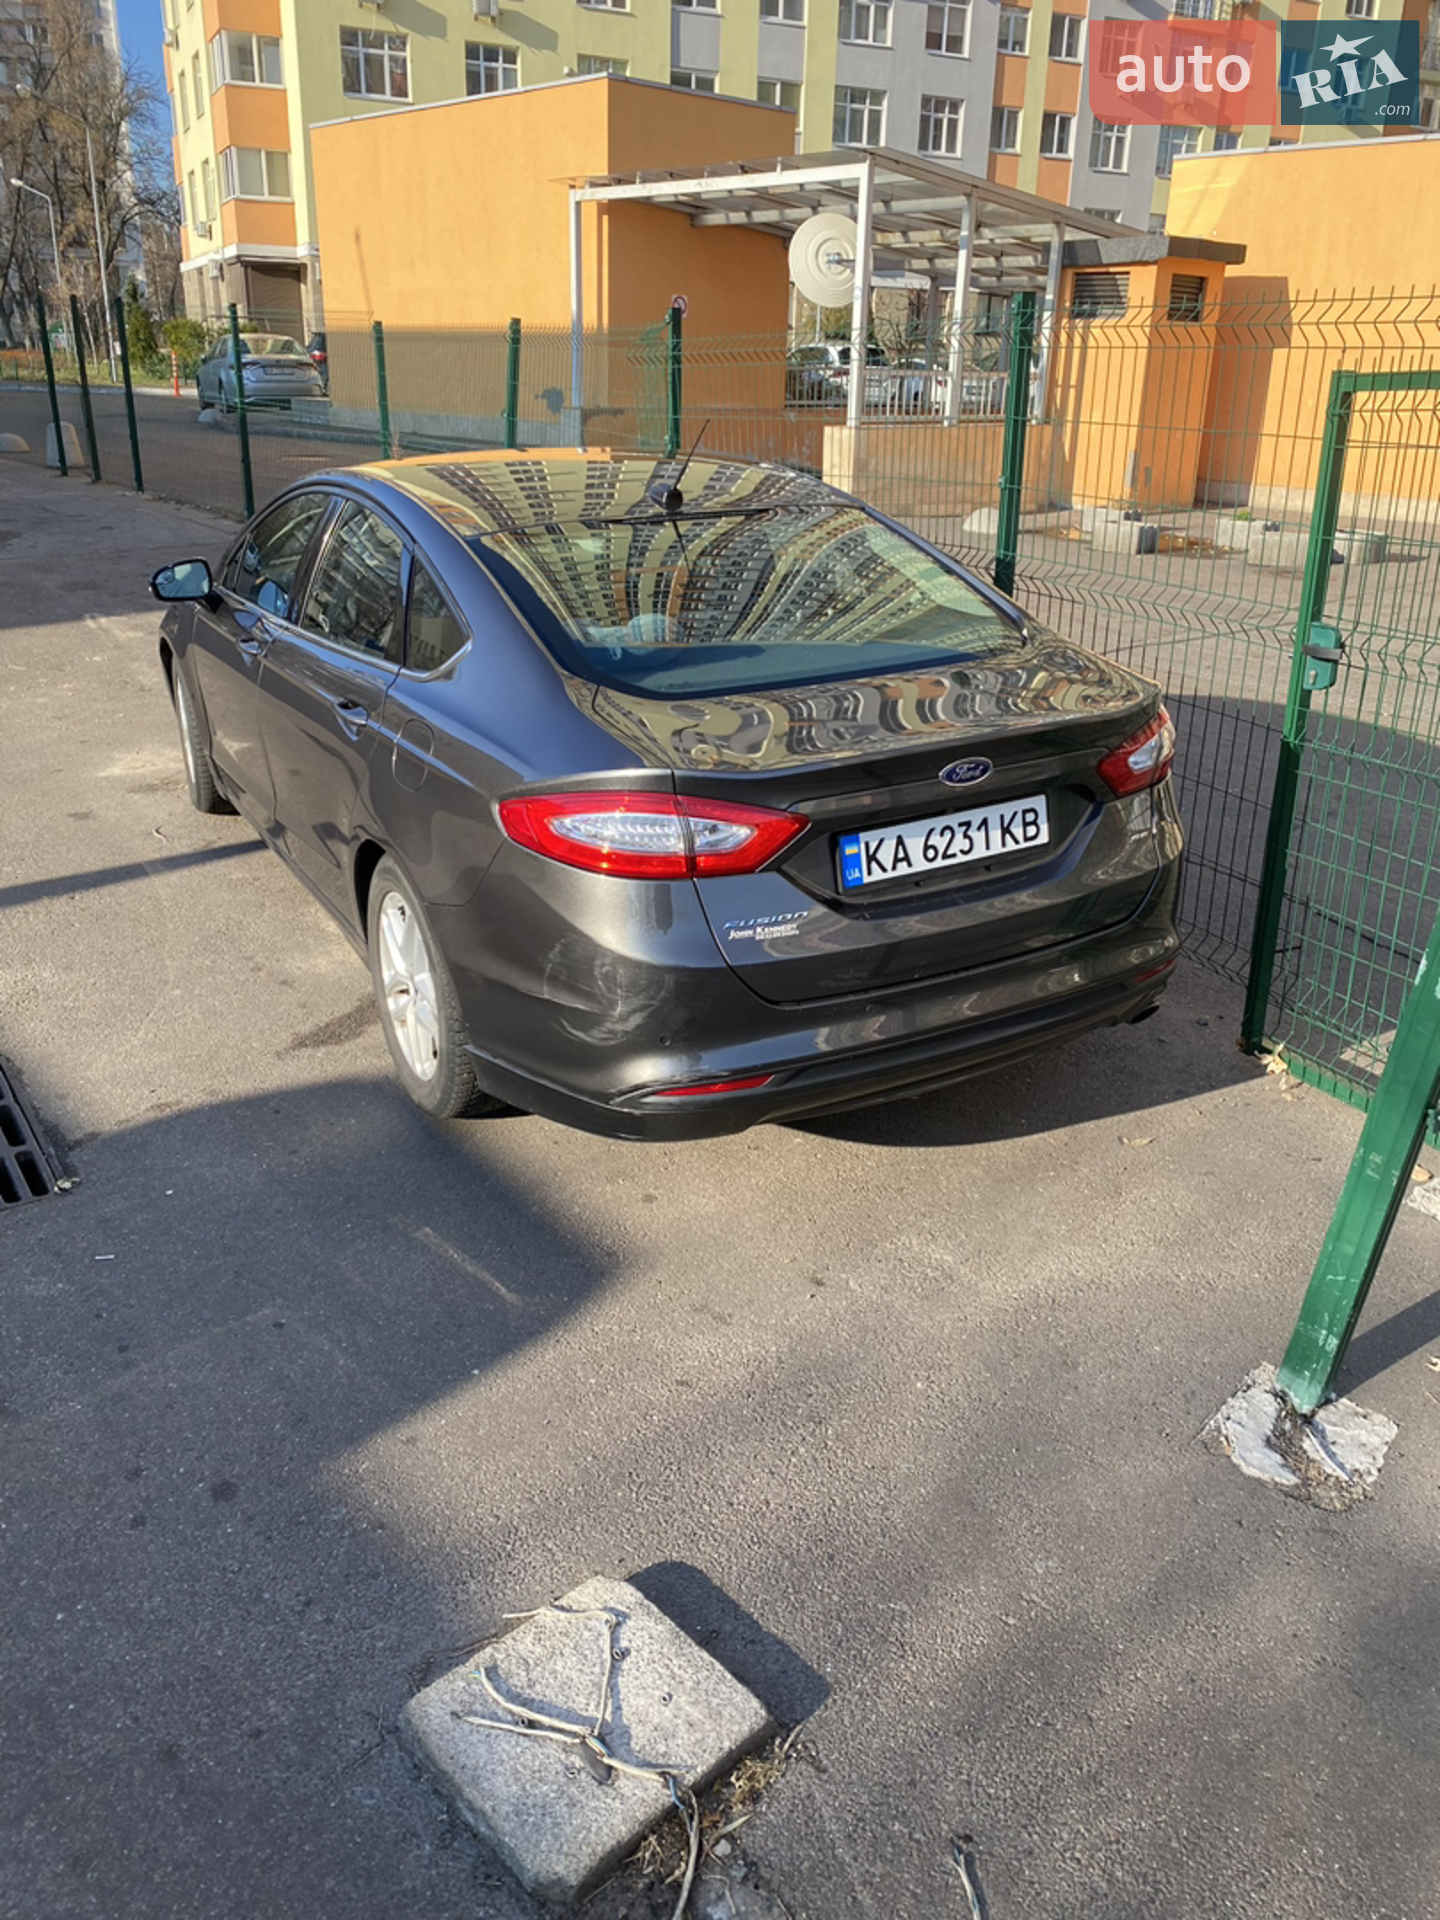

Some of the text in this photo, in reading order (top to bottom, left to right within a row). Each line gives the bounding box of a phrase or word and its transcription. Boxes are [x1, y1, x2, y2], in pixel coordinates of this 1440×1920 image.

[953, 763, 984, 781] Ford
[864, 807, 1041, 876] KA 6231 KB
[845, 867, 861, 881] UA
